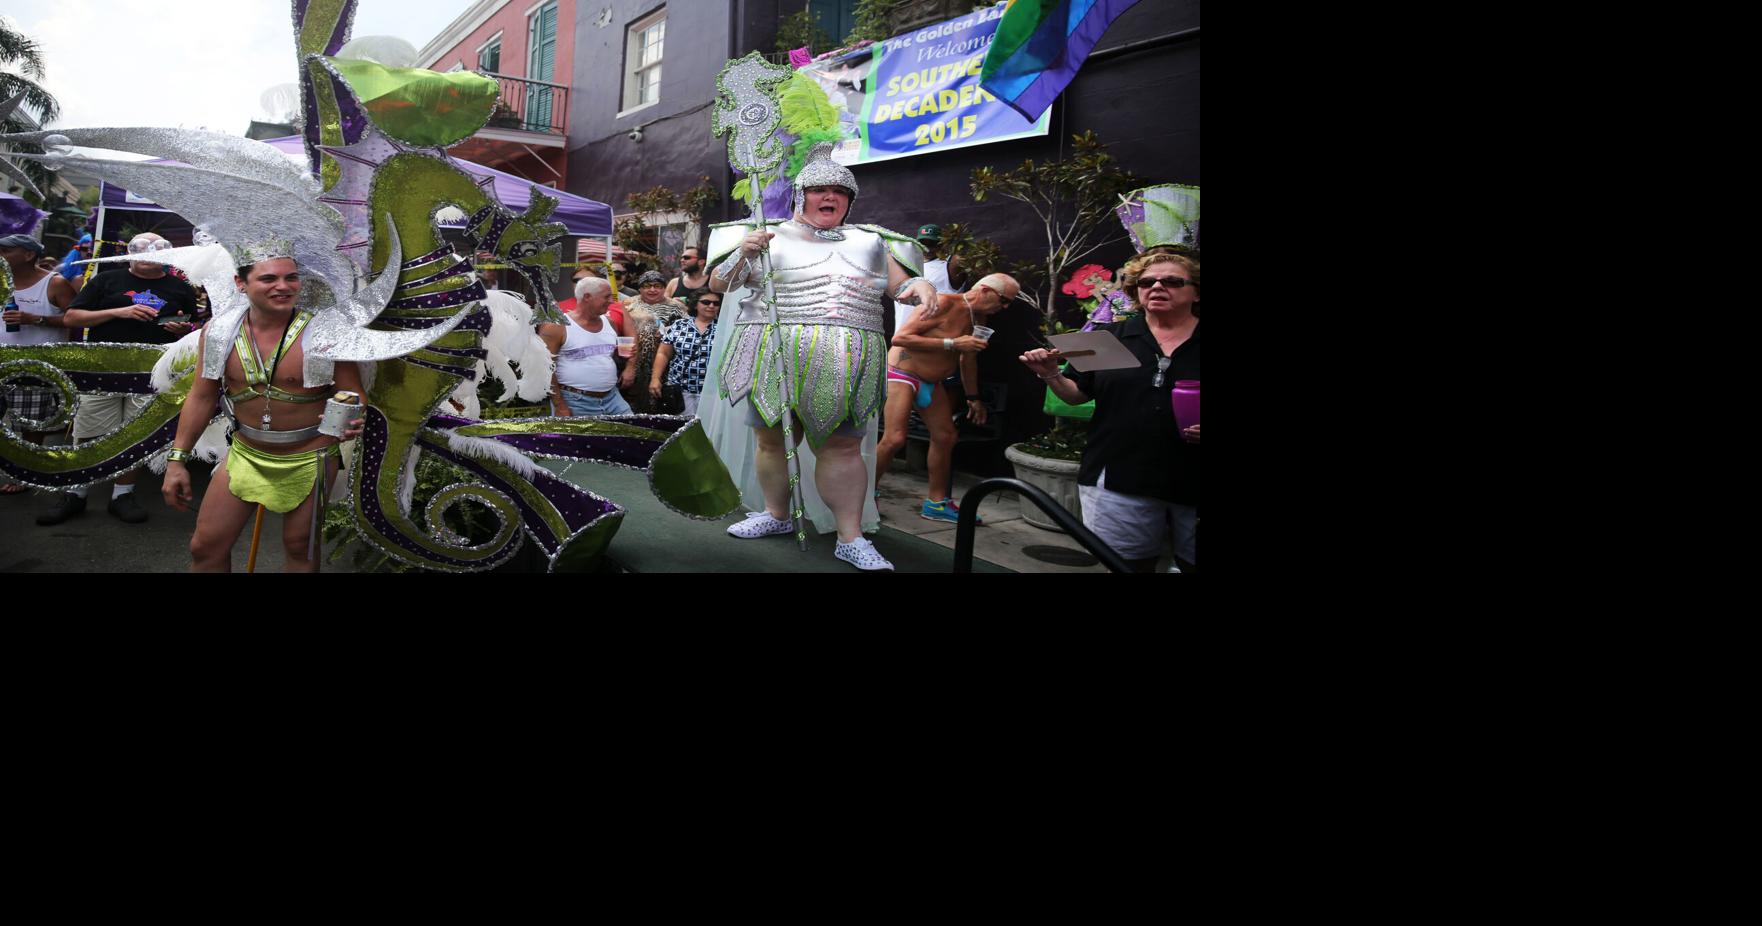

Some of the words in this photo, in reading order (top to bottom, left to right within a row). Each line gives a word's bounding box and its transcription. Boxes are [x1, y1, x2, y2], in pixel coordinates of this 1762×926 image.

[916, 19, 973, 42] Golden
[918, 33, 996, 63] Welcome
[915, 115, 977, 146] 2015
